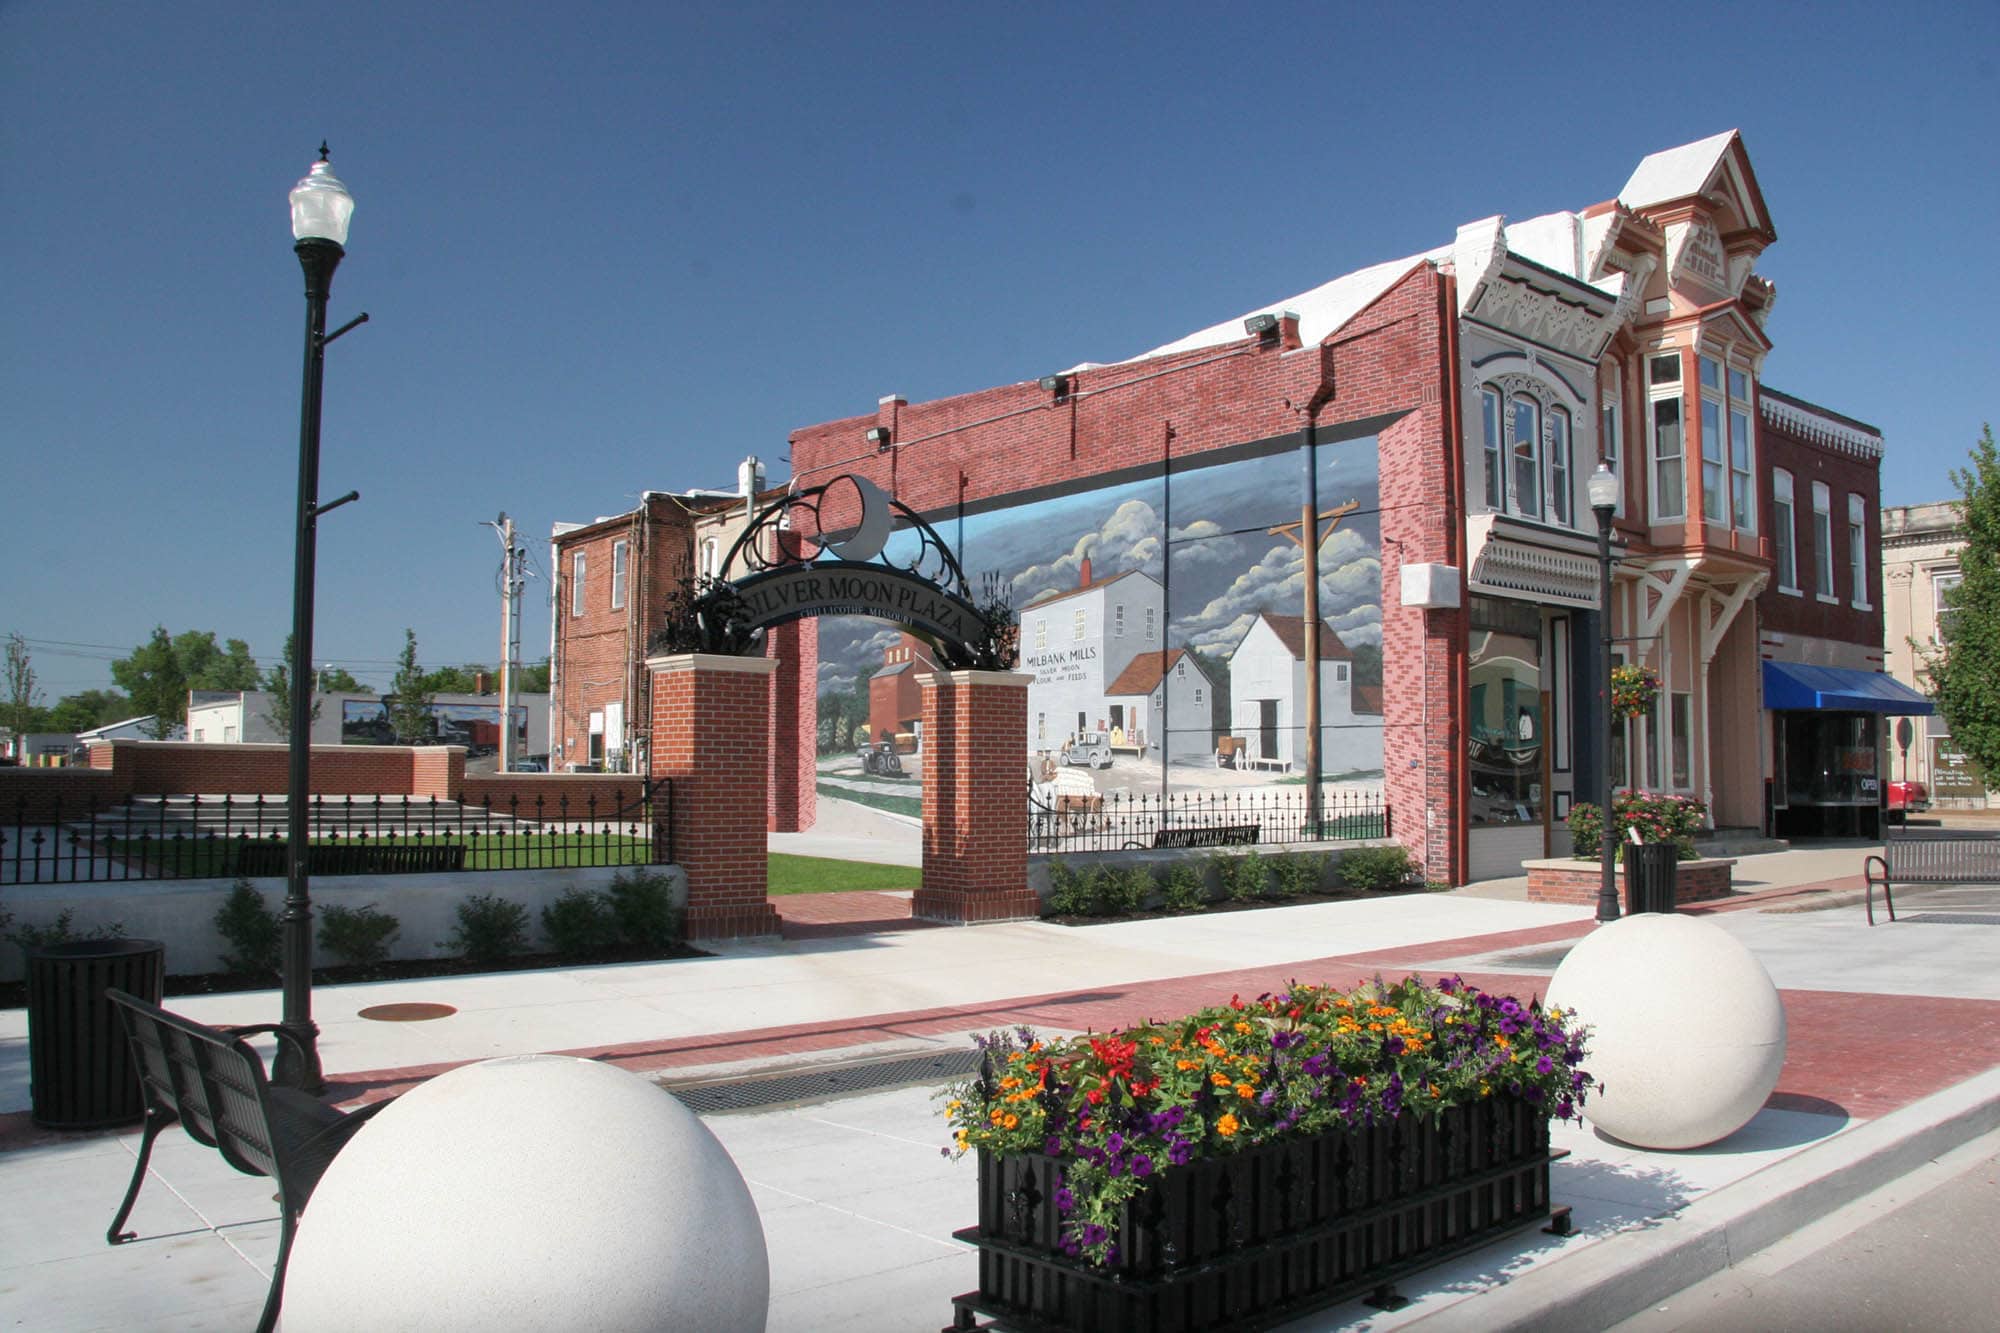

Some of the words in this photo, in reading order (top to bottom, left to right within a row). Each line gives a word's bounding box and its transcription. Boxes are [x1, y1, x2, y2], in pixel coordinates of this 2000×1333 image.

[747, 579, 823, 619] SILVER
[829, 577, 895, 601] MOON
[898, 590, 963, 637] PLAZA
[869, 607, 913, 626] MISSOURI
[1026, 651, 1067, 668] MILBANK
[1069, 647, 1096, 661] MILLS
[1062, 664, 1080, 672] MOON
